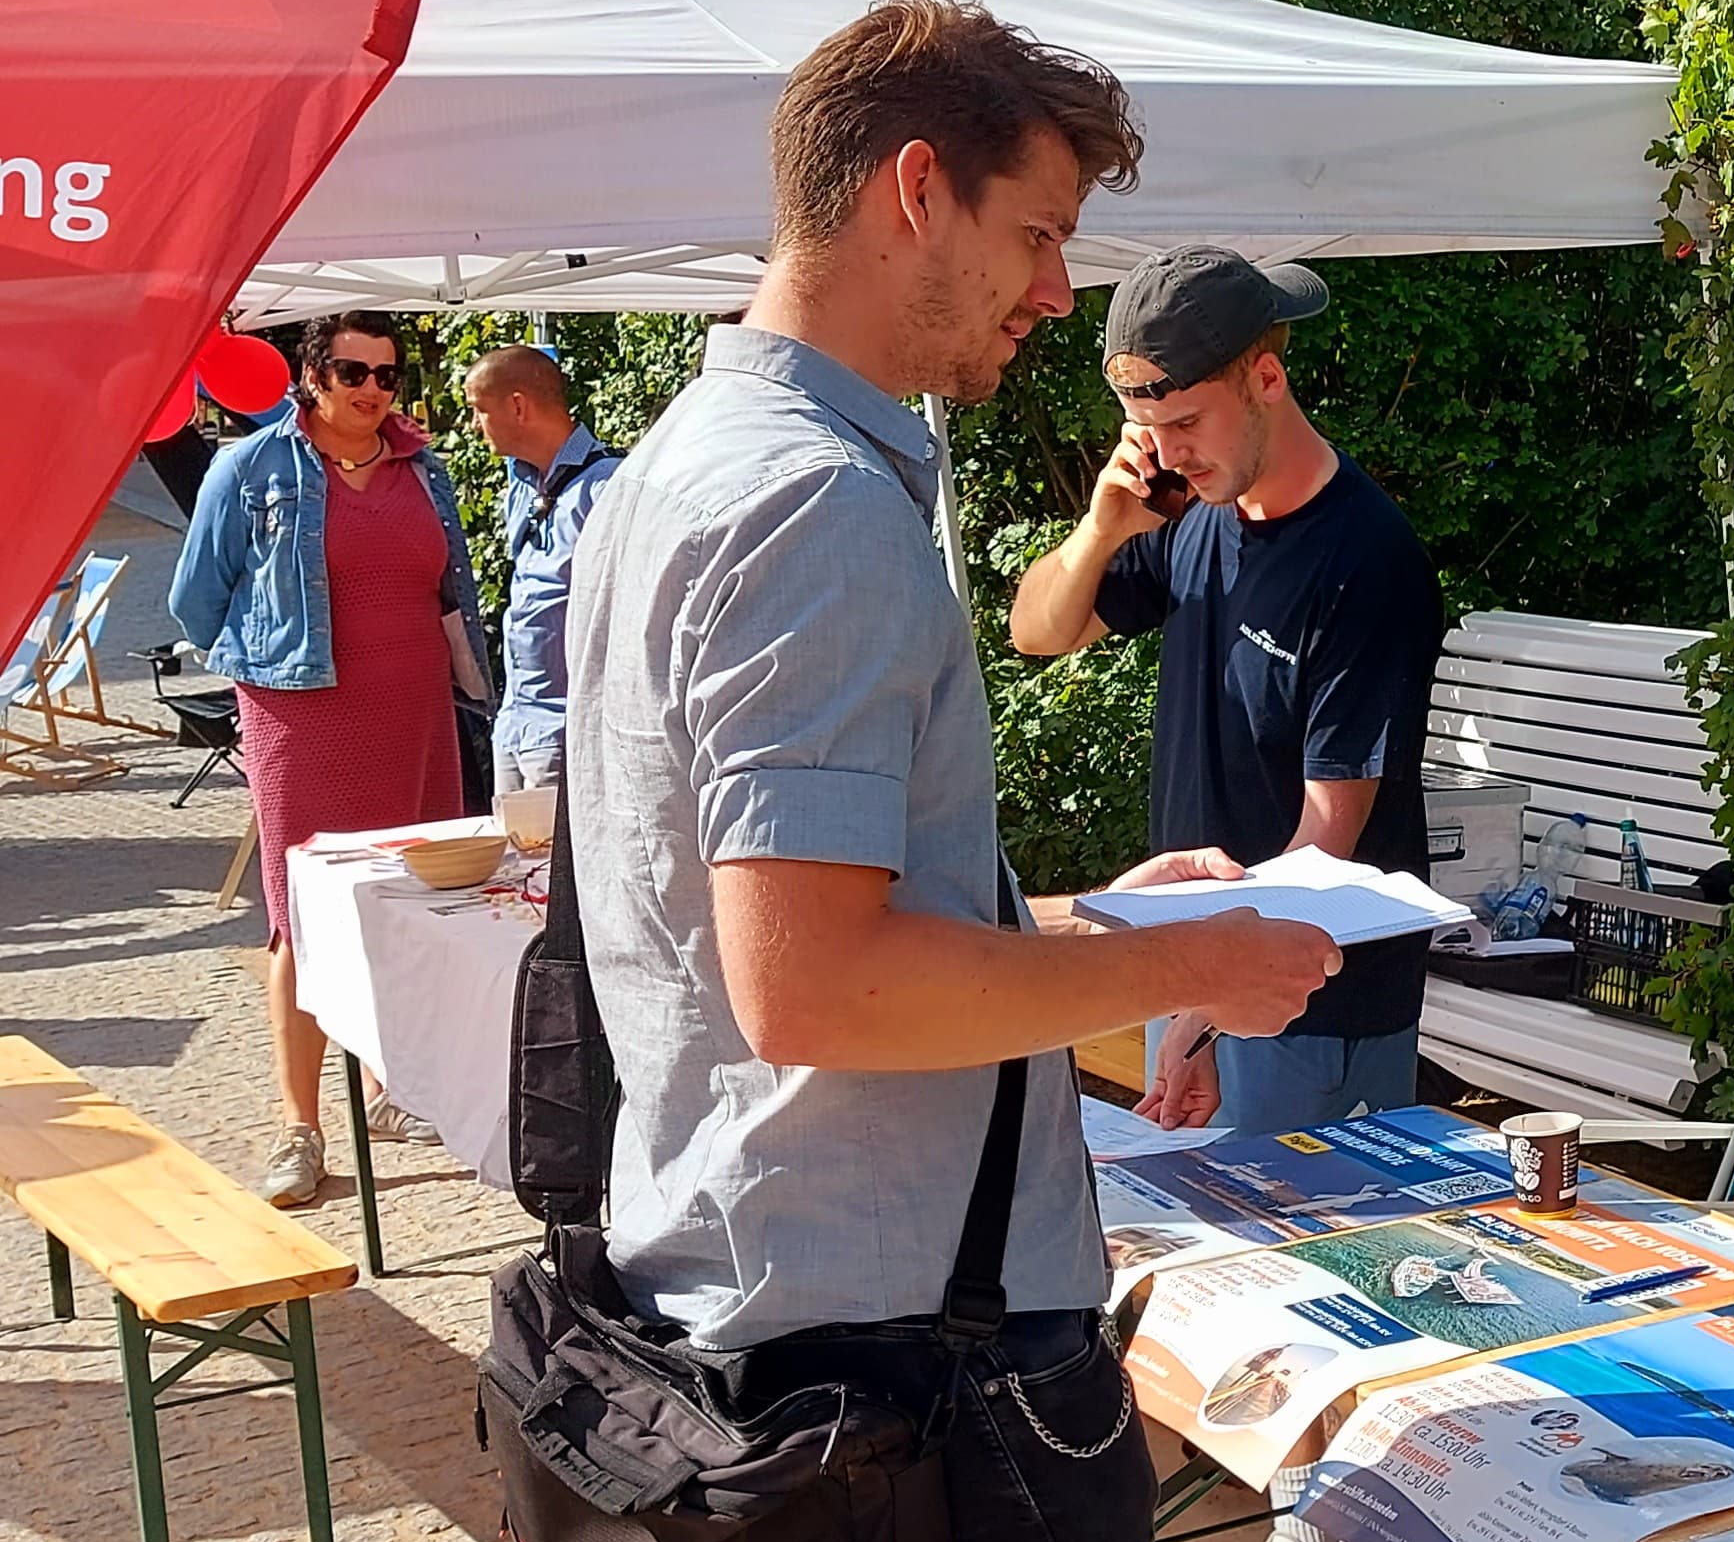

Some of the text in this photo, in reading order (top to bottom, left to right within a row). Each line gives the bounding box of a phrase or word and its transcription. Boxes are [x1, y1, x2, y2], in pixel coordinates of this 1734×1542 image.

[1346, 1120, 1477, 1173] HAFENRUNDFAHRT
[1612, 1222, 1660, 1250] NACH
[1413, 1423, 1436, 1442] ca.
[1430, 1433, 1471, 1460] 15:00
[1463, 1448, 1493, 1471] Uhr
[1429, 1412, 1486, 1447] Koserow
[1391, 1435, 1453, 1479] Zinnowitz
[1391, 1461, 1431, 1492] 14:30
[1422, 1479, 1453, 1503] Uhr
